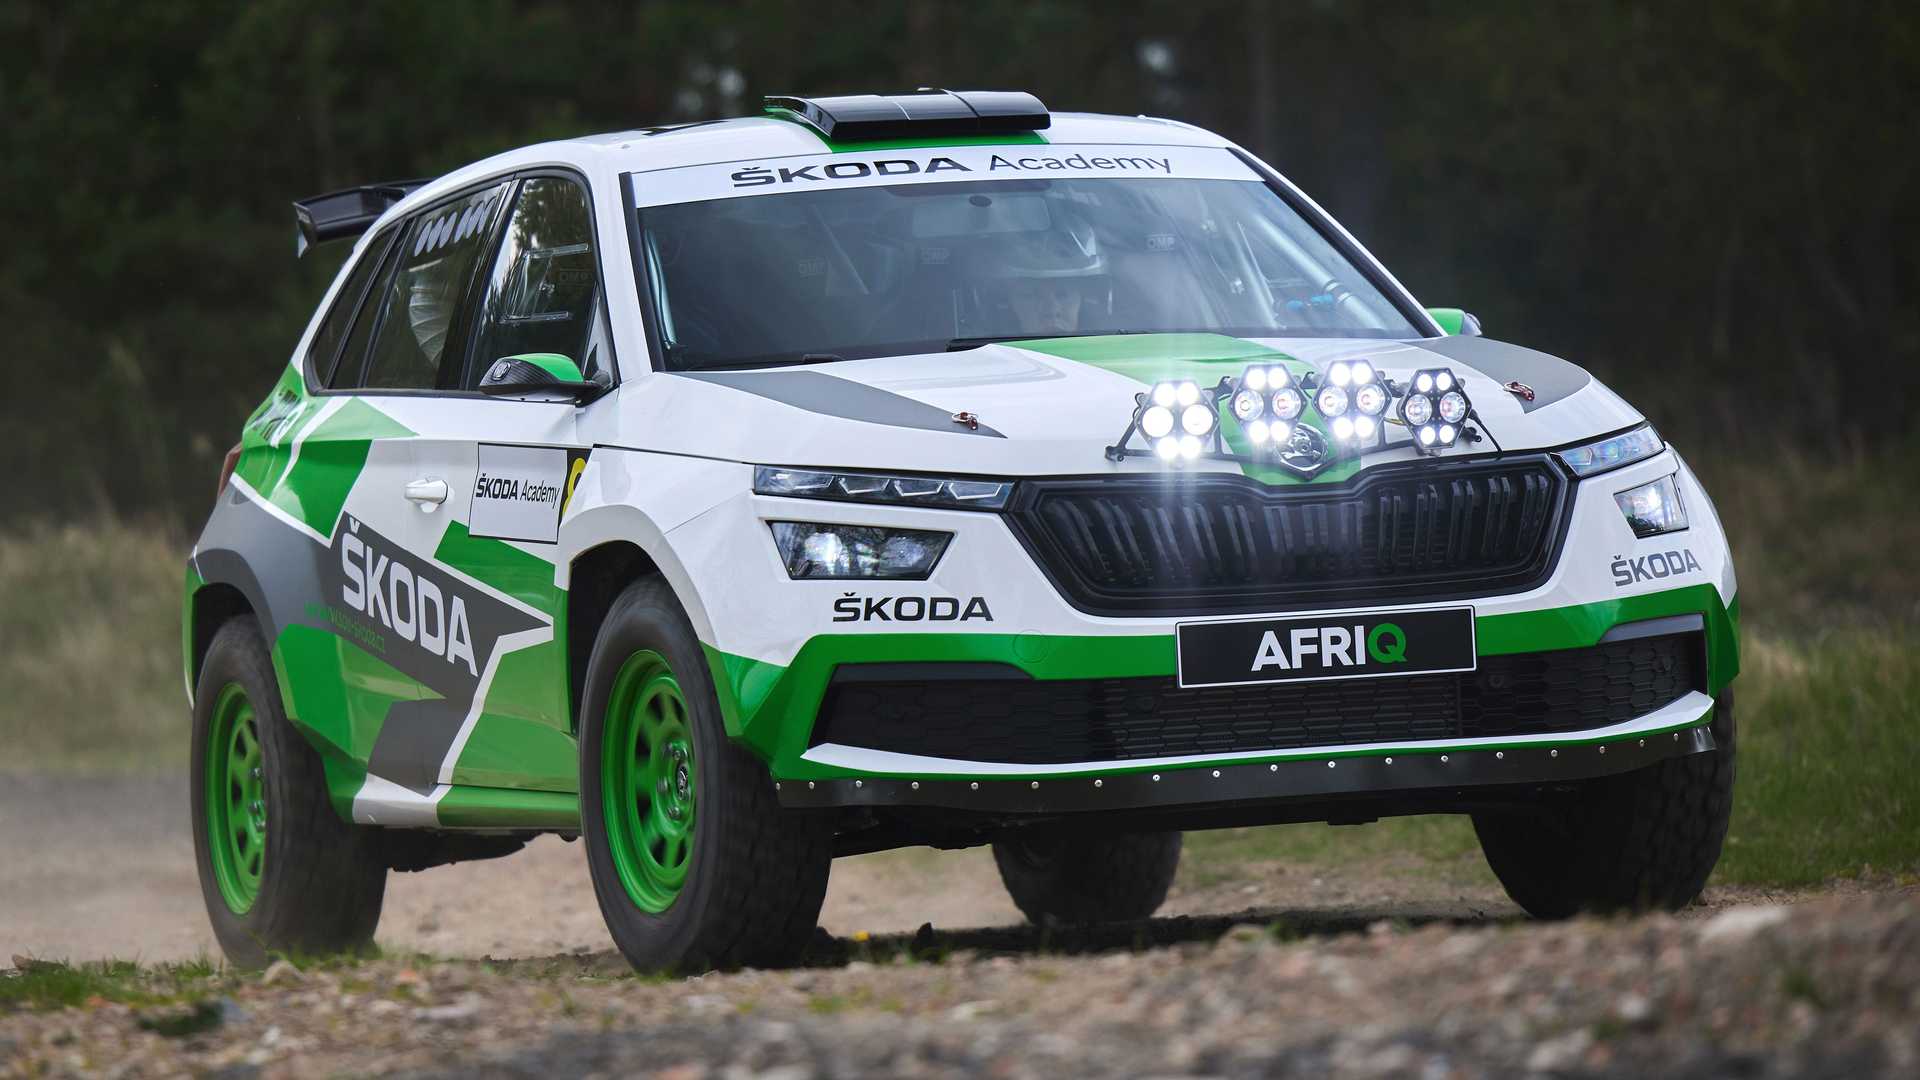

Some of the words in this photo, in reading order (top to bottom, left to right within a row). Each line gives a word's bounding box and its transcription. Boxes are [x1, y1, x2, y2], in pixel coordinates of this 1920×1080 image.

[731, 156, 972, 188] ŠKODA
[989, 153, 1172, 175] Academy
[475, 473, 519, 501] ŠKODA
[519, 479, 561, 509] Academy
[1610, 548, 1702, 587] ŠKODA
[341, 516, 479, 678] ŠKODA
[832, 592, 994, 622] ŠKODA
[1250, 622, 1408, 672] AFRIQ
